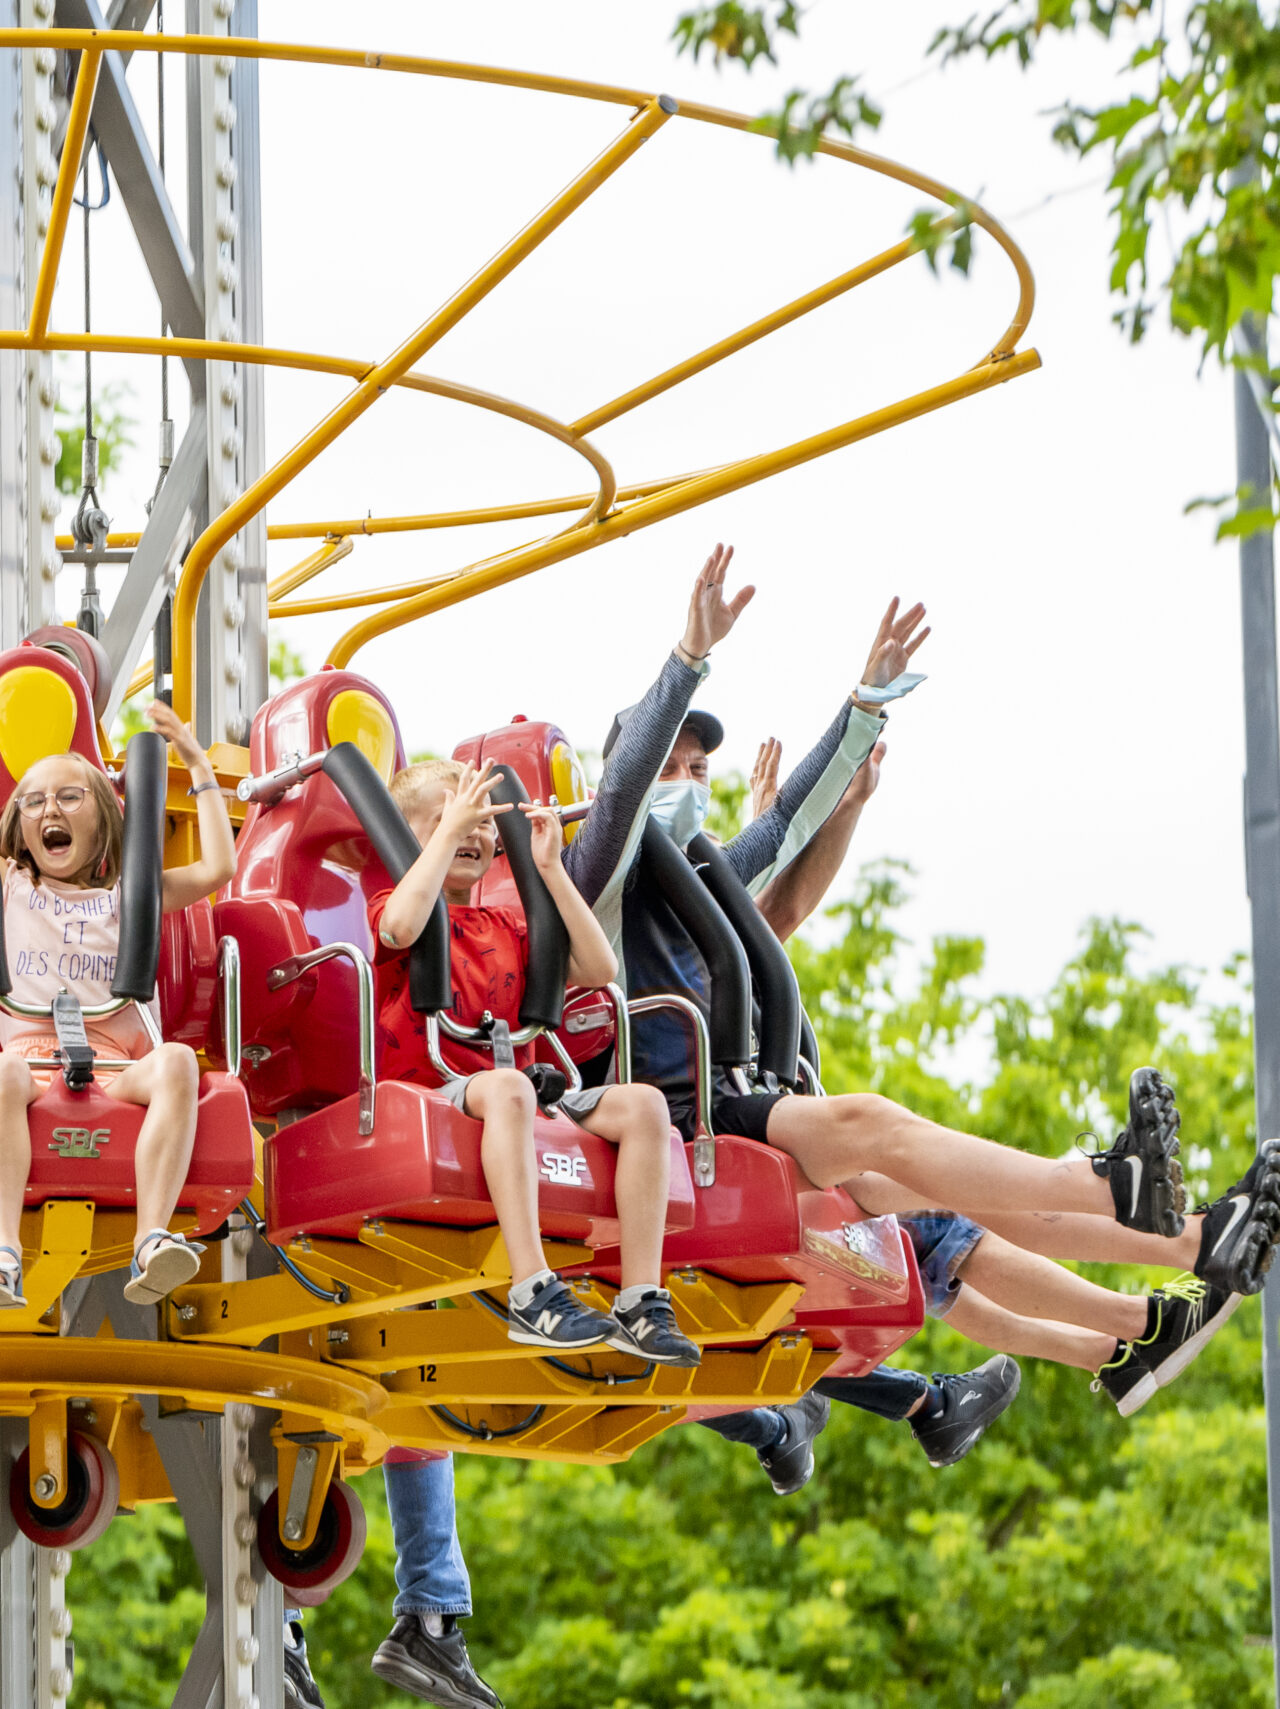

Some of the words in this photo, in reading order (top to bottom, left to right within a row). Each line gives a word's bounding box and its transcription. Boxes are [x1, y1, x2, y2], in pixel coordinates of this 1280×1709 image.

[63, 921, 88, 944] ET
[16, 950, 49, 976] DES
[48, 1127, 111, 1152] SBF
[540, 1152, 587, 1178] SBF
[221, 1299, 228, 1318] 2
[534, 1309, 563, 1335] N
[629, 1316, 656, 1341] N
[378, 1328, 386, 1347] 1
[418, 1364, 437, 1382] 12
